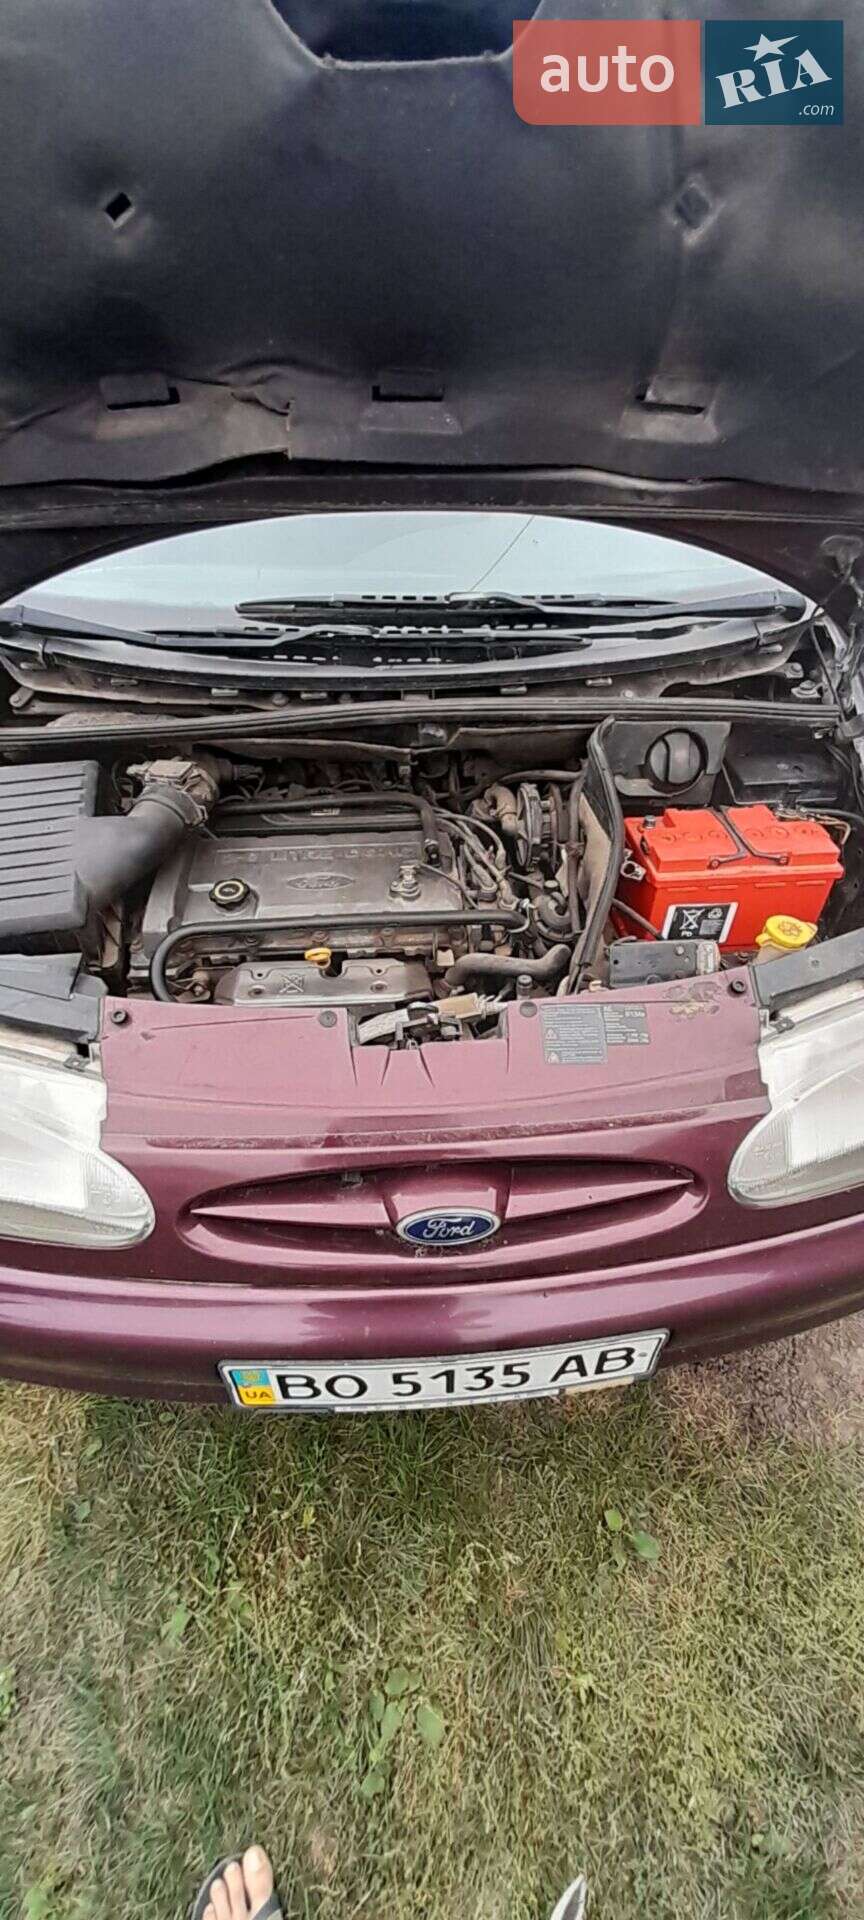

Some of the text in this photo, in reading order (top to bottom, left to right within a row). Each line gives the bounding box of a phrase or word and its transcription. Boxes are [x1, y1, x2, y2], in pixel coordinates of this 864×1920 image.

[422, 1217, 476, 1238] Ford
[275, 1346, 636, 1399] BO 5135 AB
[244, 1390, 273, 1399] UA
